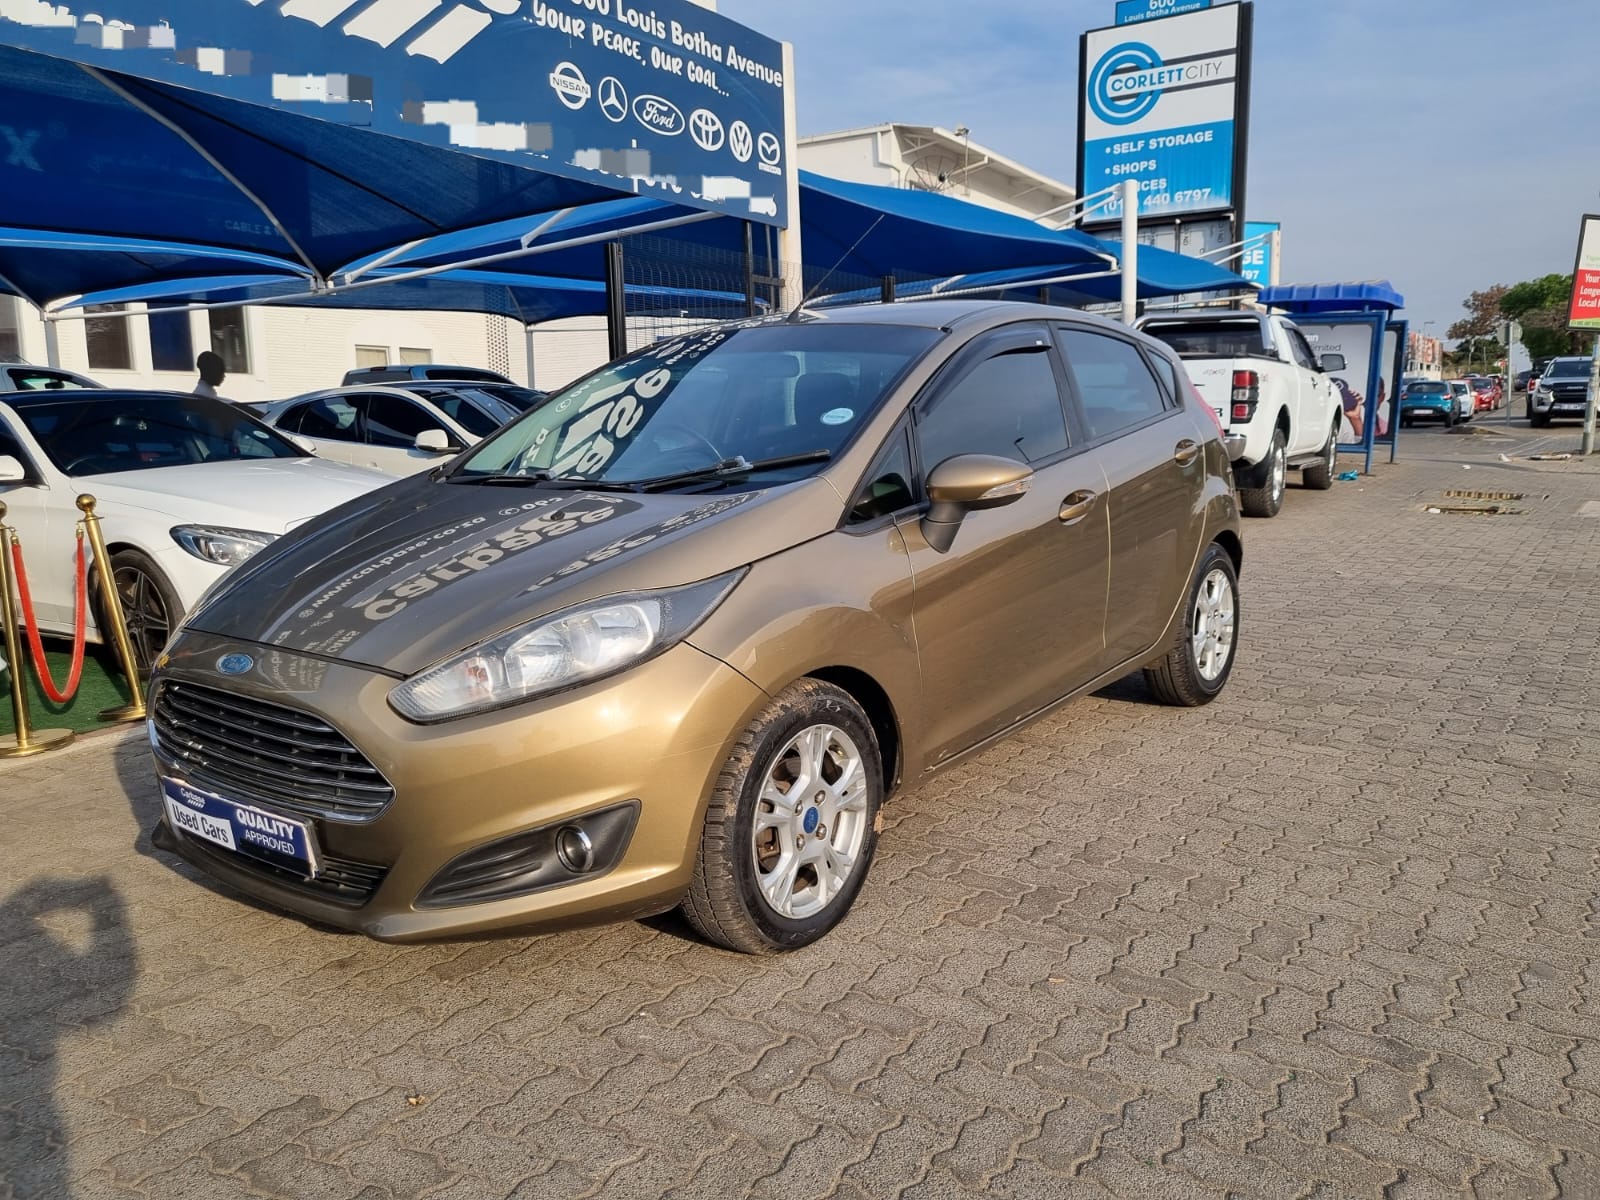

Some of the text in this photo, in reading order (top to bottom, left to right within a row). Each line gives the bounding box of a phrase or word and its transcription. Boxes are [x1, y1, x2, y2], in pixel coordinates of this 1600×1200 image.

[1124, 2, 1201, 23] Louis Botha Avenue
[591, 22, 647, 67] PEACE,
[651, 46, 683, 77] OUR
[616, 0, 783, 88] Louis Botha Avenue
[552, 76, 589, 96] NISSAN
[642, 100, 676, 129] Ford
[1112, 130, 1214, 155] SELF STORAGE
[1112, 159, 1157, 176] SHOPS
[1143, 193, 1170, 207] 440
[1174, 187, 1212, 202] 6797
[1577, 297, 1597, 308] Local
[1579, 284, 1600, 298] Longe
[172, 803, 229, 844] Used Cars
[235, 808, 294, 840] QUALITY
[244, 829, 296, 856] APPROVED
